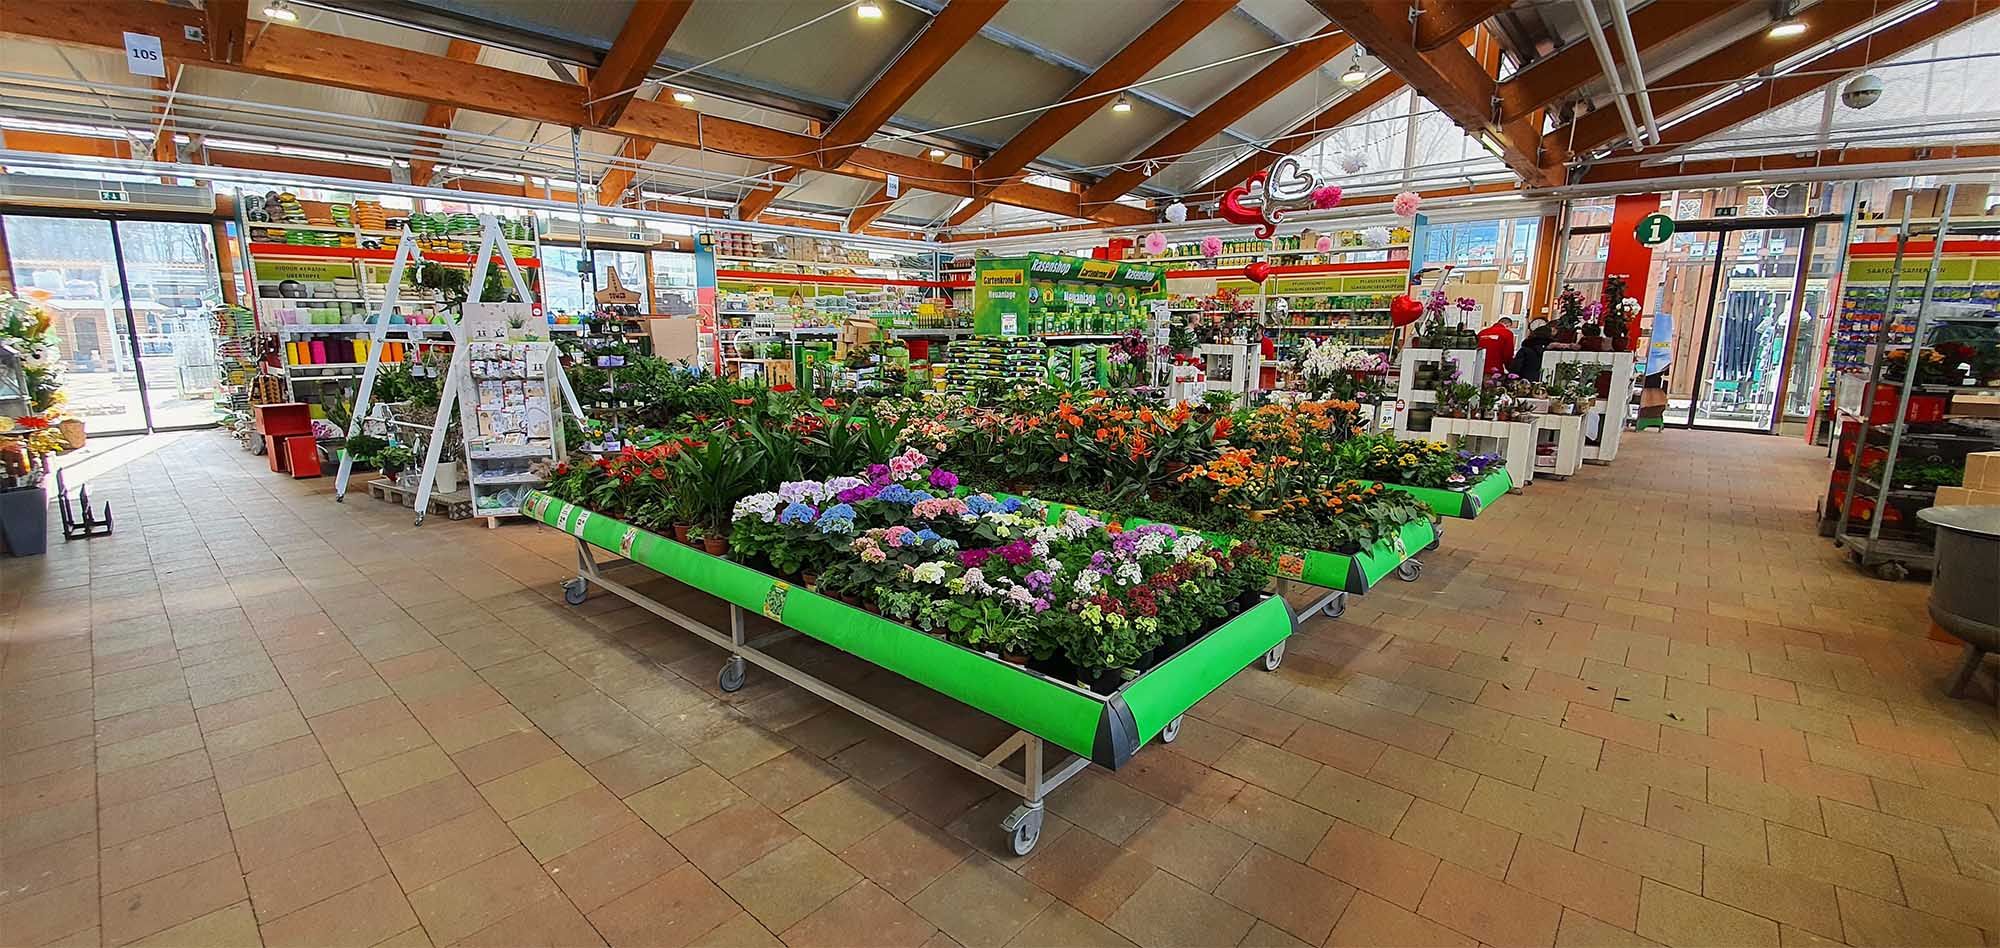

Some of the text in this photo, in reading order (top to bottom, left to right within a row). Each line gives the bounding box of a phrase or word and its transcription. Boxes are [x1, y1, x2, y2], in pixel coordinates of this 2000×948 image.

[132, 48, 158, 61] 105
[1648, 217, 1662, 242] i
[1031, 259, 1071, 276] Rasenshop
[983, 276, 1014, 285] Gartenkrone
[1125, 268, 1156, 283] Rasenshop
[988, 290, 1016, 300] Neuanlage
[1063, 290, 1096, 306] Neuanlage
